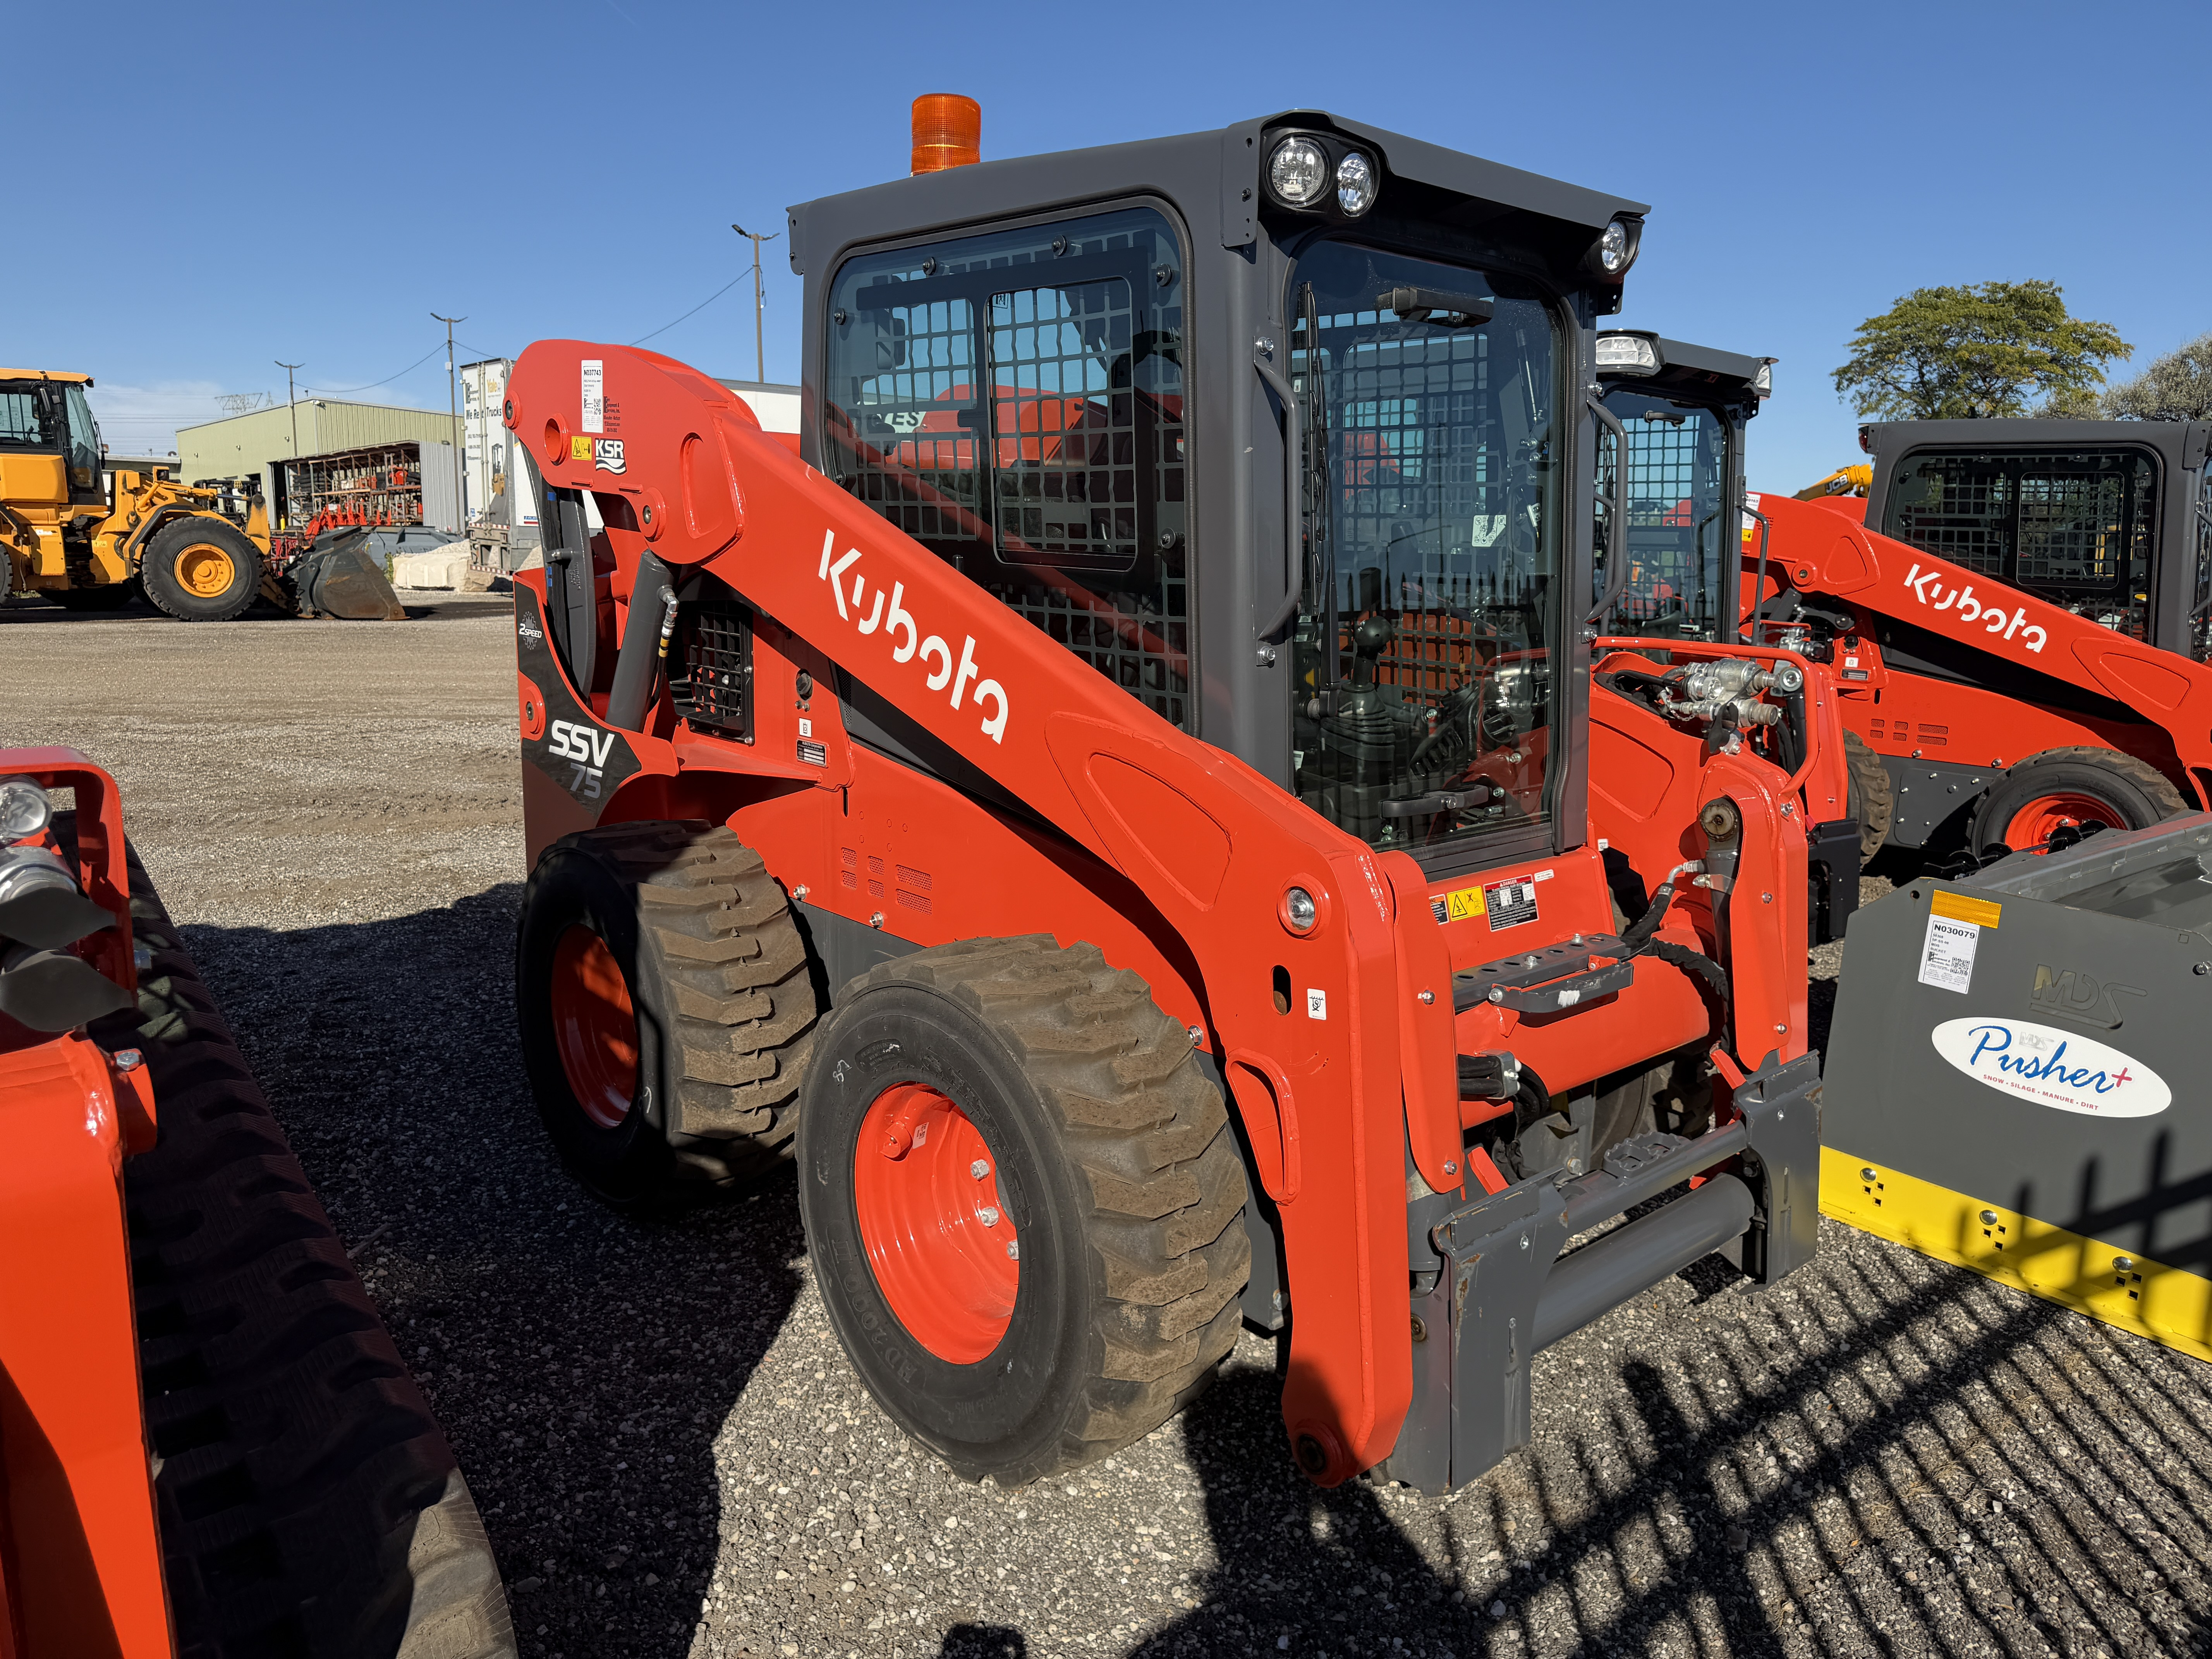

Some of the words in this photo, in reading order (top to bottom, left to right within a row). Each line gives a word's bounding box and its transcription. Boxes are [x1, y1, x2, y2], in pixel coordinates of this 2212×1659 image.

[466, 410, 472, 419] We
[474, 409, 484, 419] Ret
[486, 406, 502, 417] Trucks
[595, 440, 624, 458] KSR
[1826, 474, 1848, 494] JCB
[1904, 563, 2047, 653] Kubota
[818, 528, 1009, 745] Kubota
[549, 720, 615, 768] SSV
[570, 762, 603, 799] 75
[1934, 924, 1975, 939] N030079
[1983, 1074, 2004, 1084] SNOW
[2010, 1082, 2036, 1093] SILAGE
[2042, 1091, 2074, 1104] MANURE
[2080, 1101, 2099, 1111] DIRT
